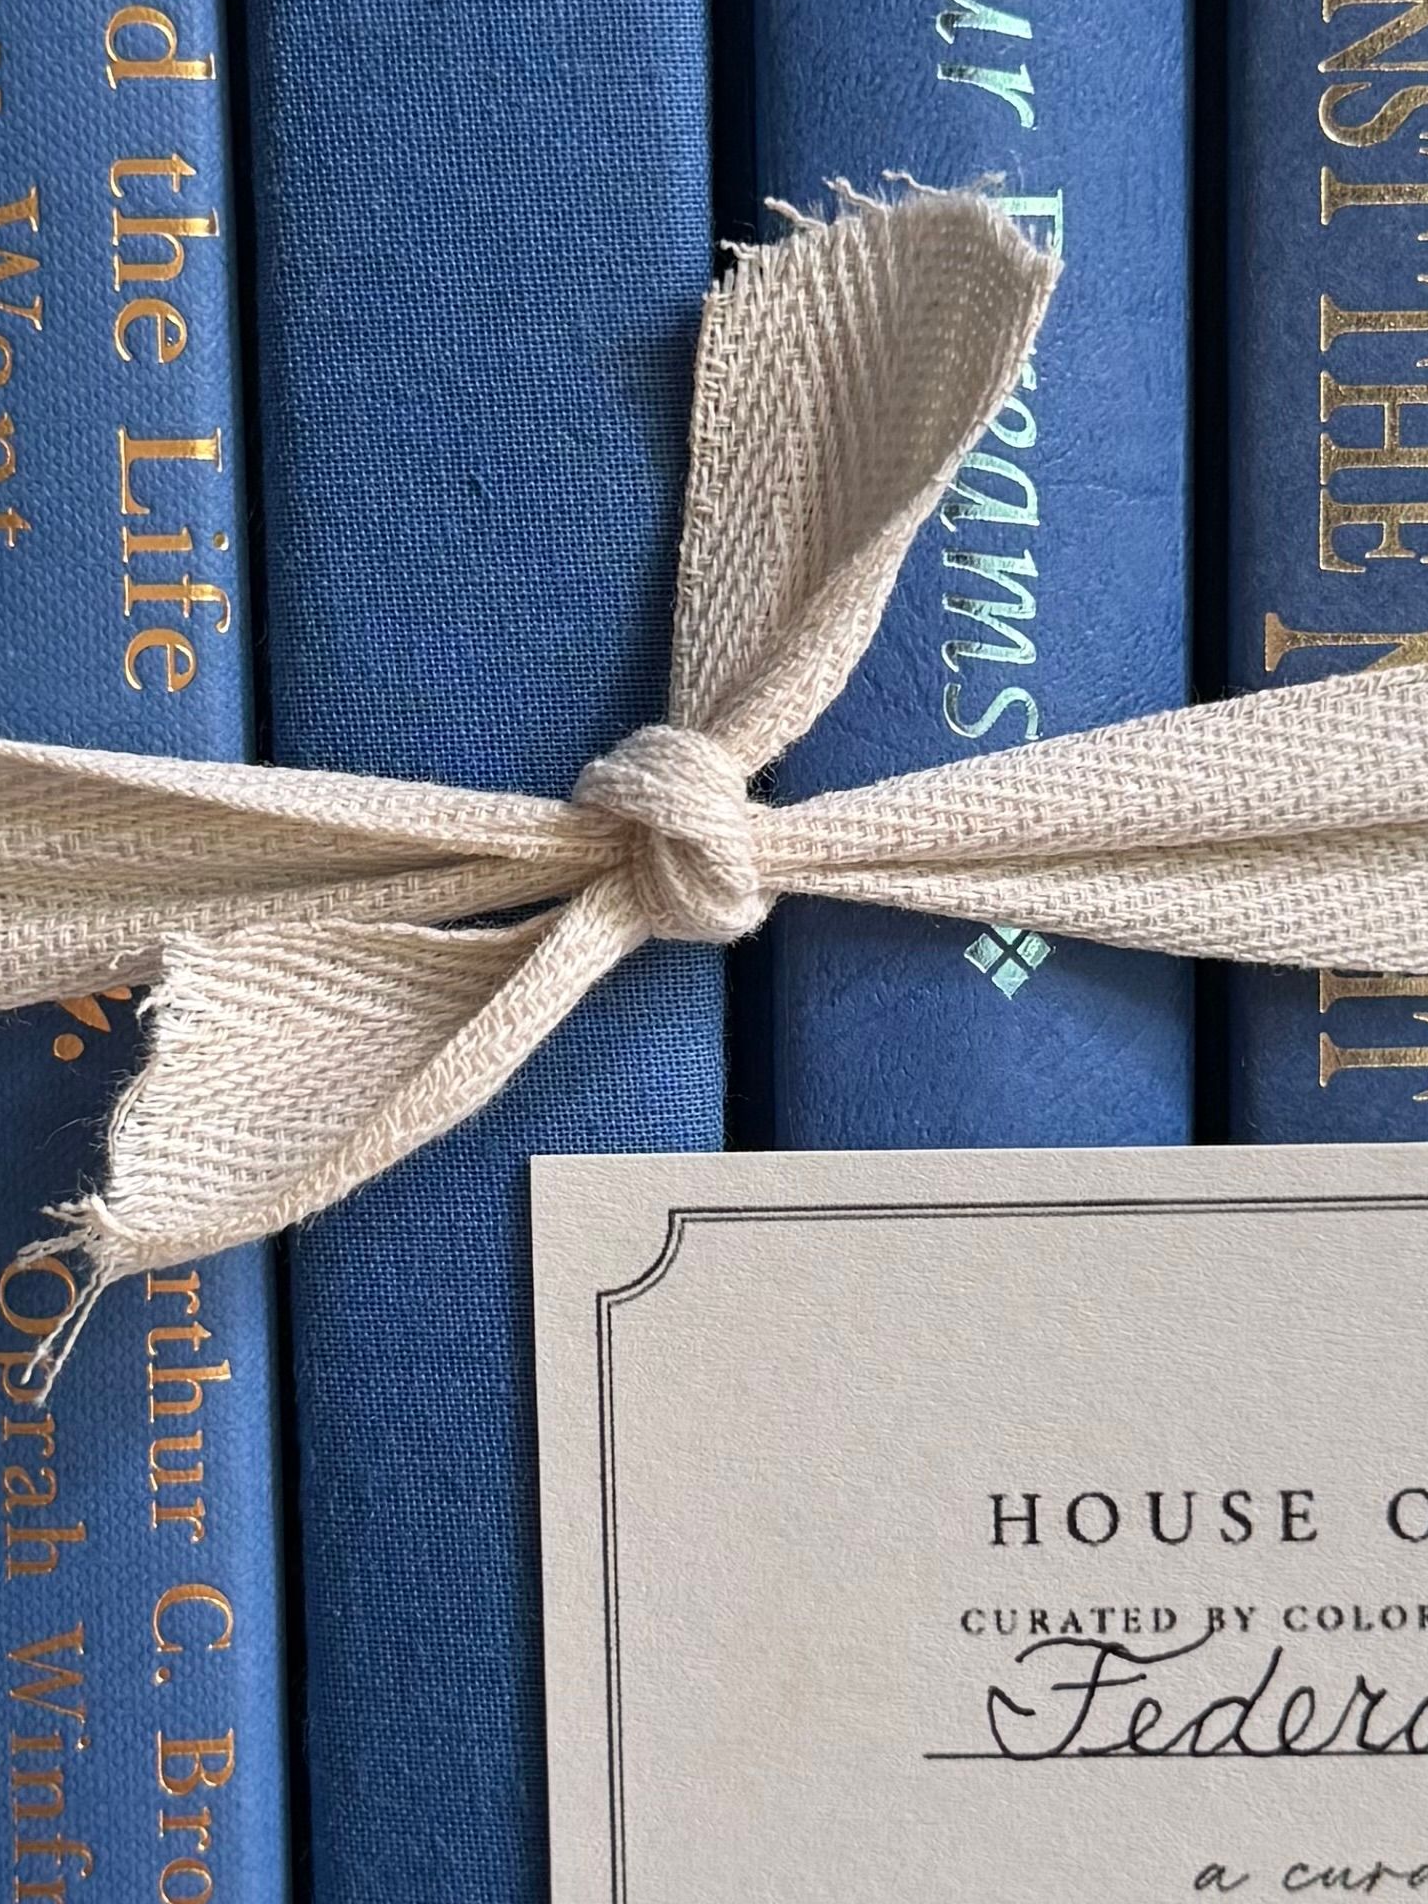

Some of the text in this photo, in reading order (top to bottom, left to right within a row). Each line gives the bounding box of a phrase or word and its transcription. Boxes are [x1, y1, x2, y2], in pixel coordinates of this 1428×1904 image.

[107, 152, 220, 365] the
[116, 425, 231, 694] Life
[146, 1269, 232, 1544] rthur
[986, 1488, 1319, 1549] HOUSE
[152, 1582, 235, 1686] C.
[960, 1607, 1176, 1634] CURATED
[1207, 1604, 1256, 1634] BY
[1192, 1862, 1251, 1895] a
